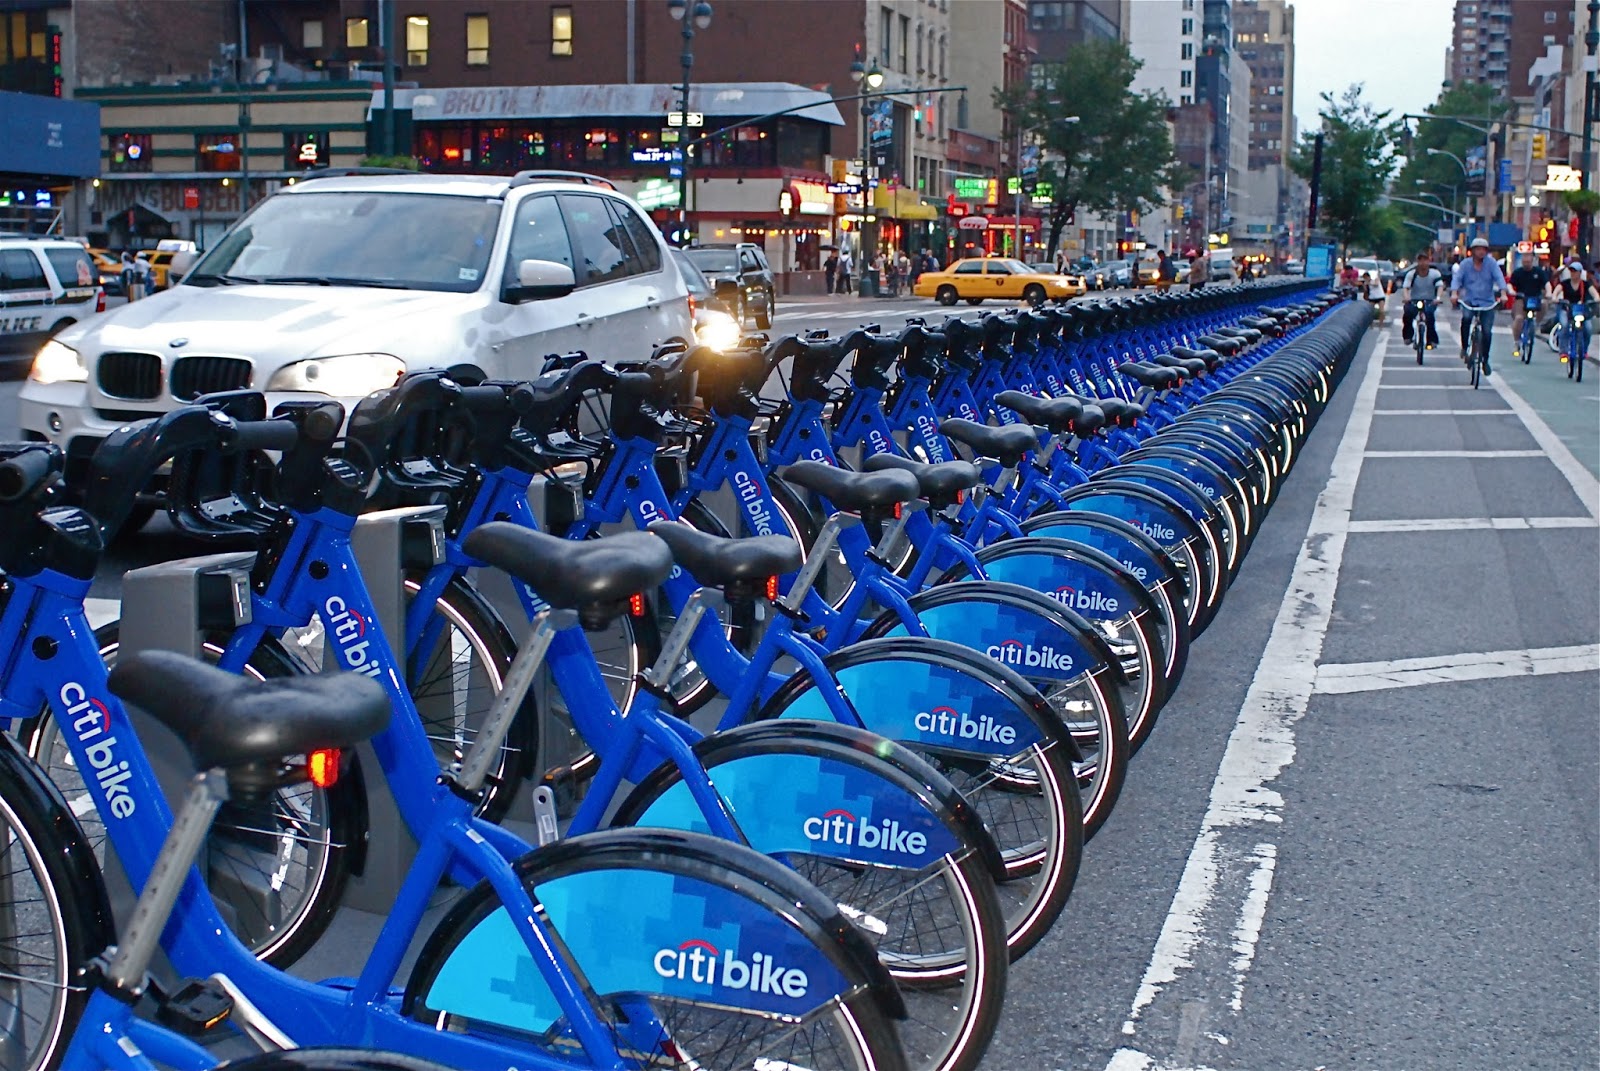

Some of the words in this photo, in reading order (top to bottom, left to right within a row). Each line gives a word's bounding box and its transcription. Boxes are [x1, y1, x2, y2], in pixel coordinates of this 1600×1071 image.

[0, 316, 42, 331] LICE
[918, 415, 937, 438] citi
[735, 471, 761, 501] citi
[746, 498, 772, 536] bike
[1142, 522, 1175, 540] bike
[1076, 590, 1119, 613] bike
[325, 595, 366, 647] citi
[986, 639, 1024, 665] citi
[1024, 644, 1073, 671] bike
[60, 681, 111, 742] citi
[914, 706, 959, 737] citi
[959, 713, 1016, 745] bike
[84, 736, 136, 820] bike
[803, 809, 856, 845] citi
[858, 816, 928, 856] bike
[653, 939, 719, 985] citi
[722, 949, 808, 998] bike
